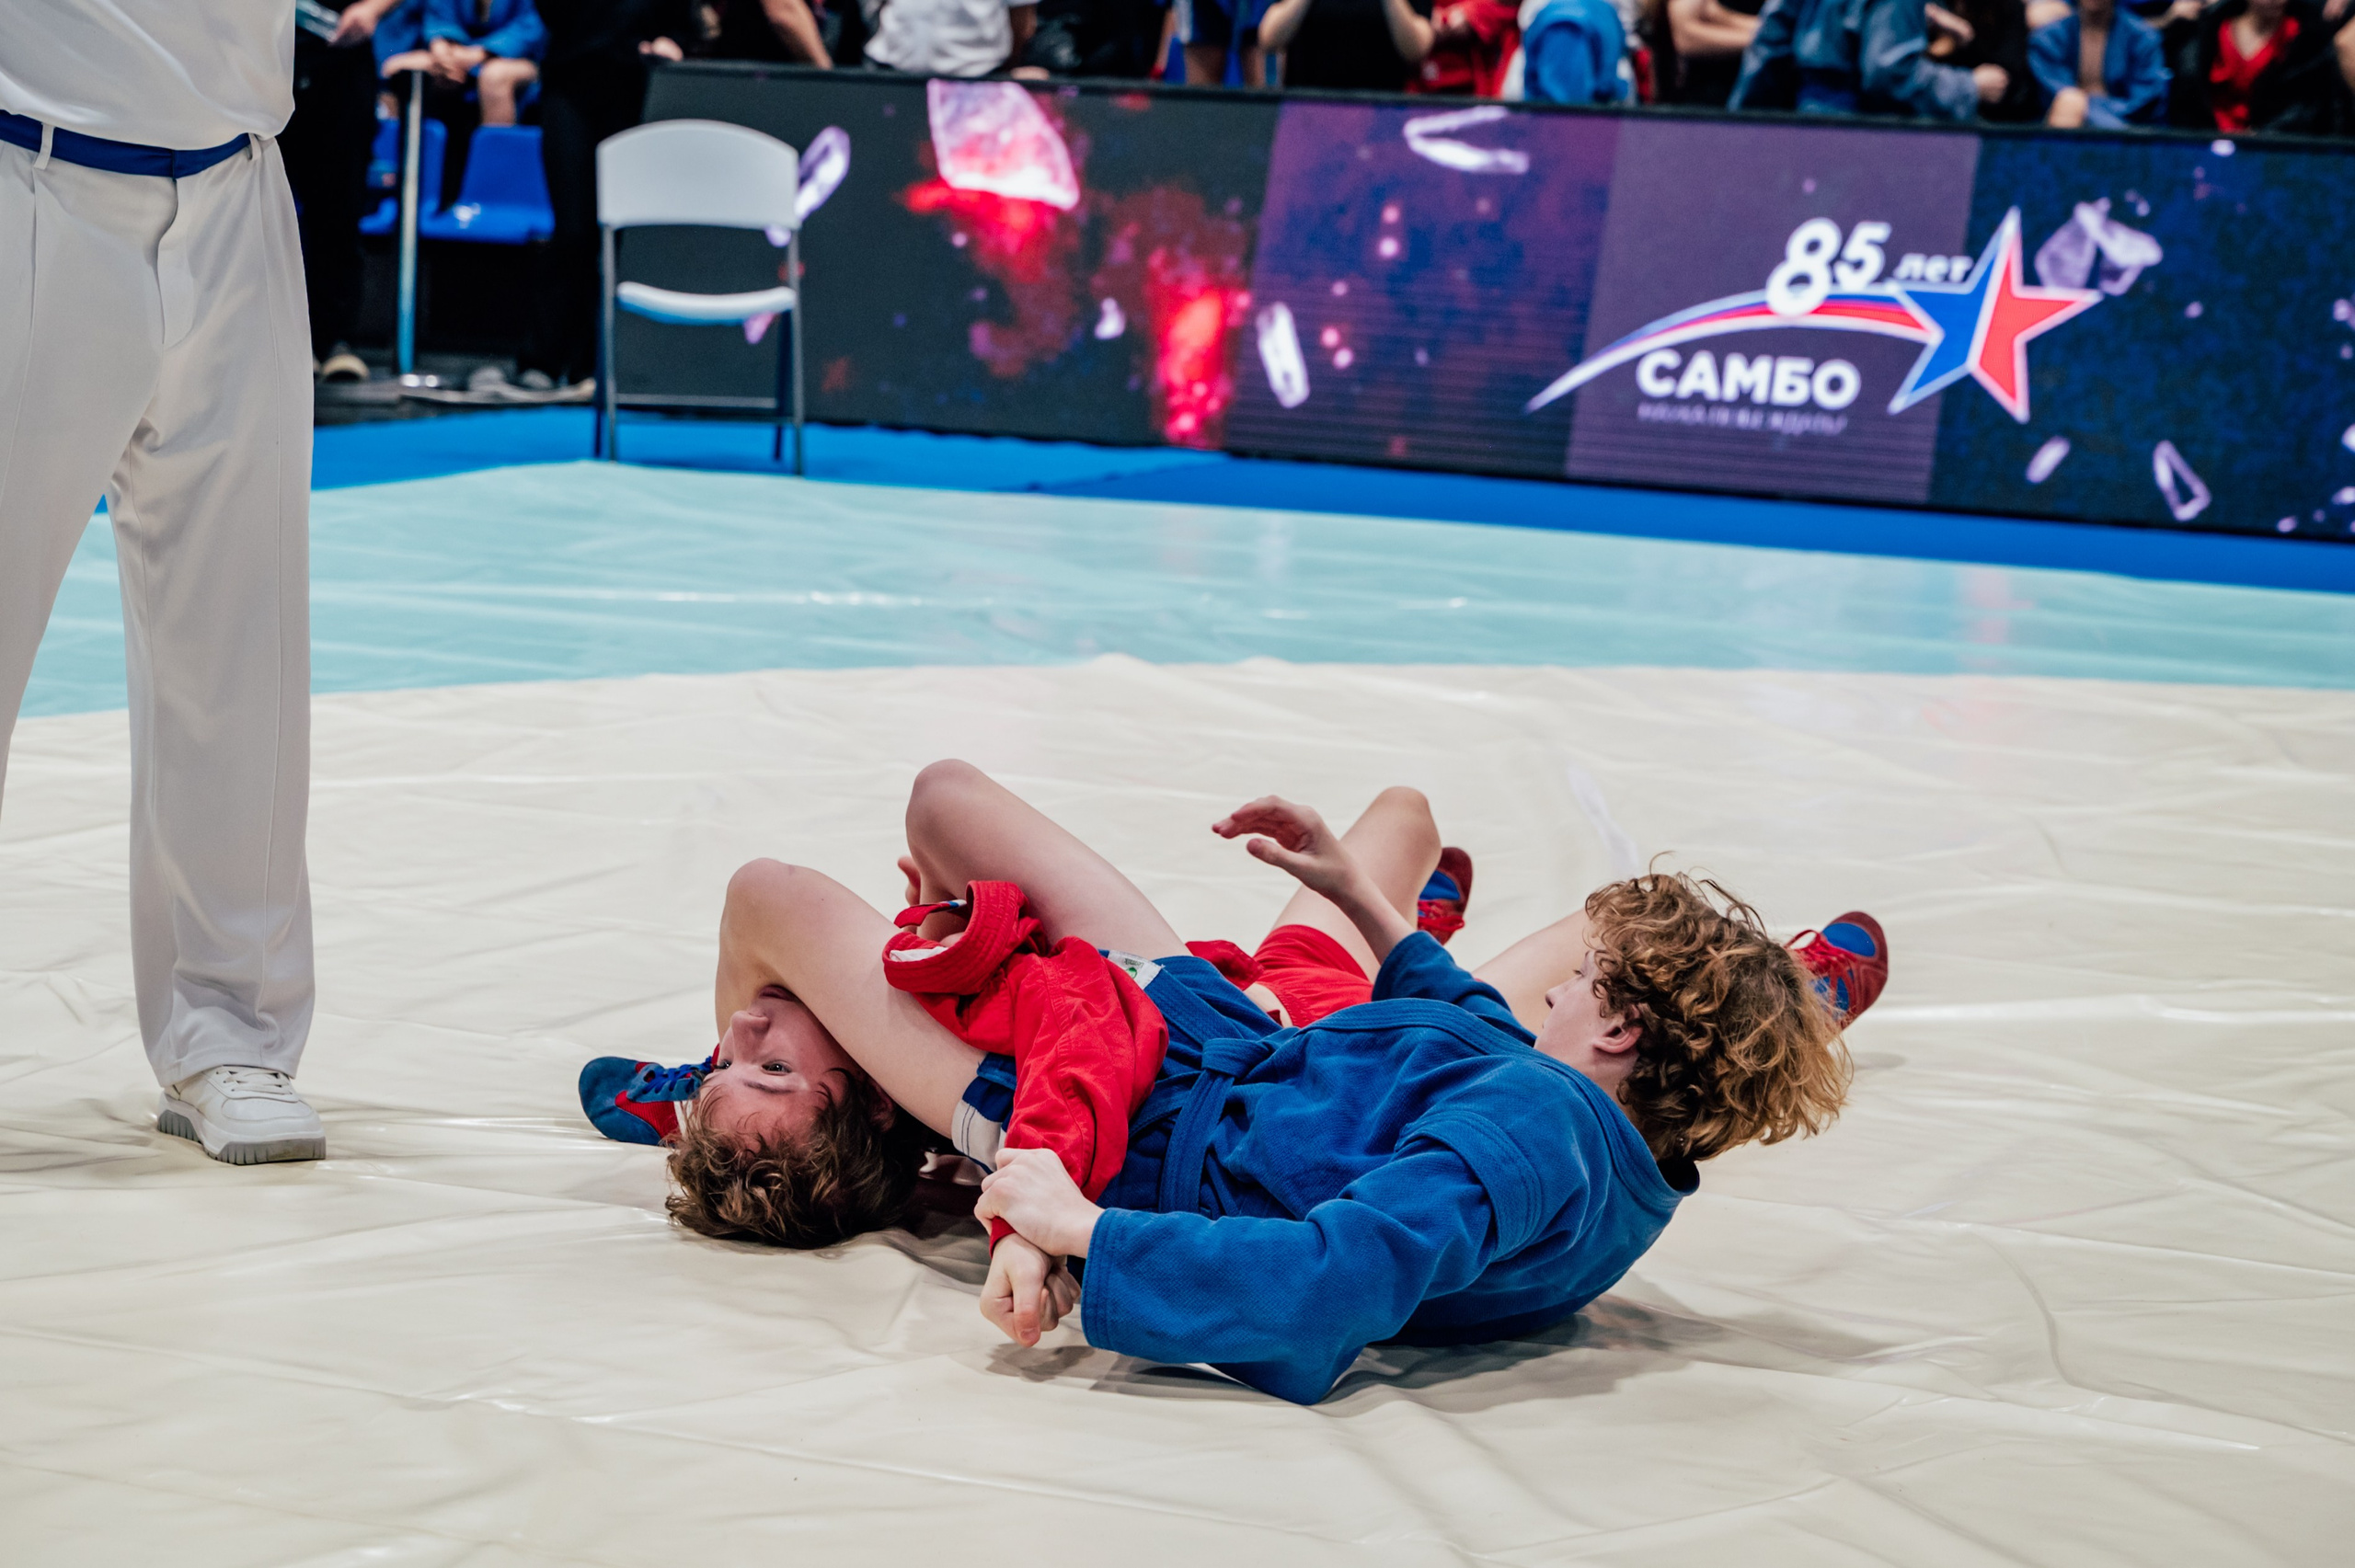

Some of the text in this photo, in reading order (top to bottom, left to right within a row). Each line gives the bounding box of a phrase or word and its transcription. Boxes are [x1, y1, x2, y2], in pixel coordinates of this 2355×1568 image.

[1766, 217, 1973, 315] 85 лет
[1635, 349, 1861, 410] САМБО
